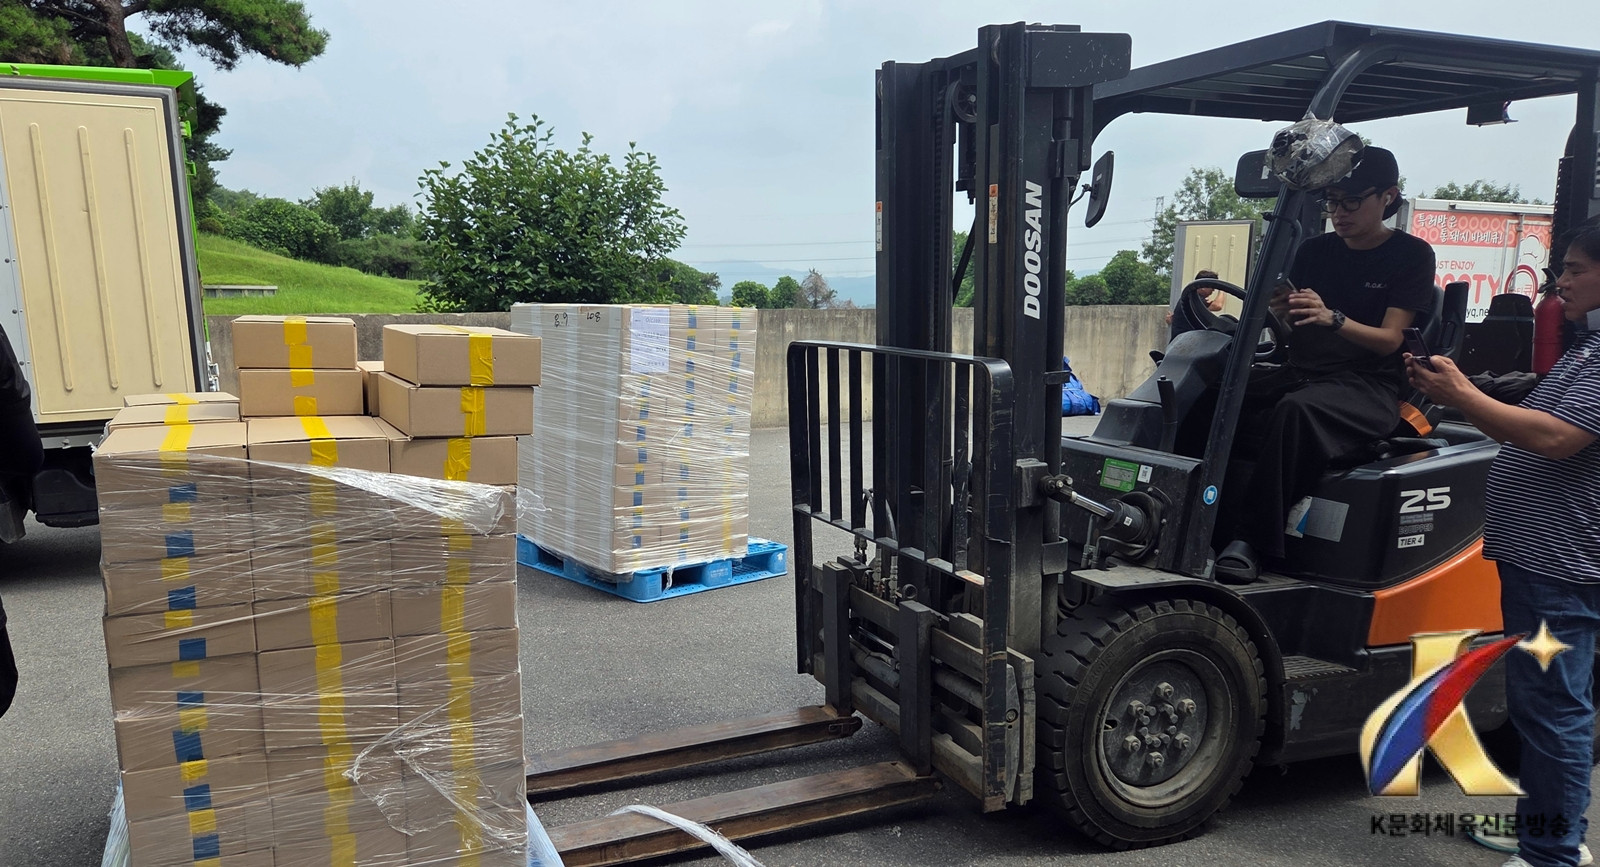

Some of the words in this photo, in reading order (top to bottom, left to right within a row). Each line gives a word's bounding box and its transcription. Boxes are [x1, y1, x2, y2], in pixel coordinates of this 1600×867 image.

[1417, 212, 1457, 228] 특허받은
[1023, 180, 1043, 319] DOOSAN
[1450, 260, 1475, 270] ENJOY
[1400, 487, 1451, 513] 25
[1400, 537, 1416, 546] TIER
[1417, 536, 1423, 544] 4
